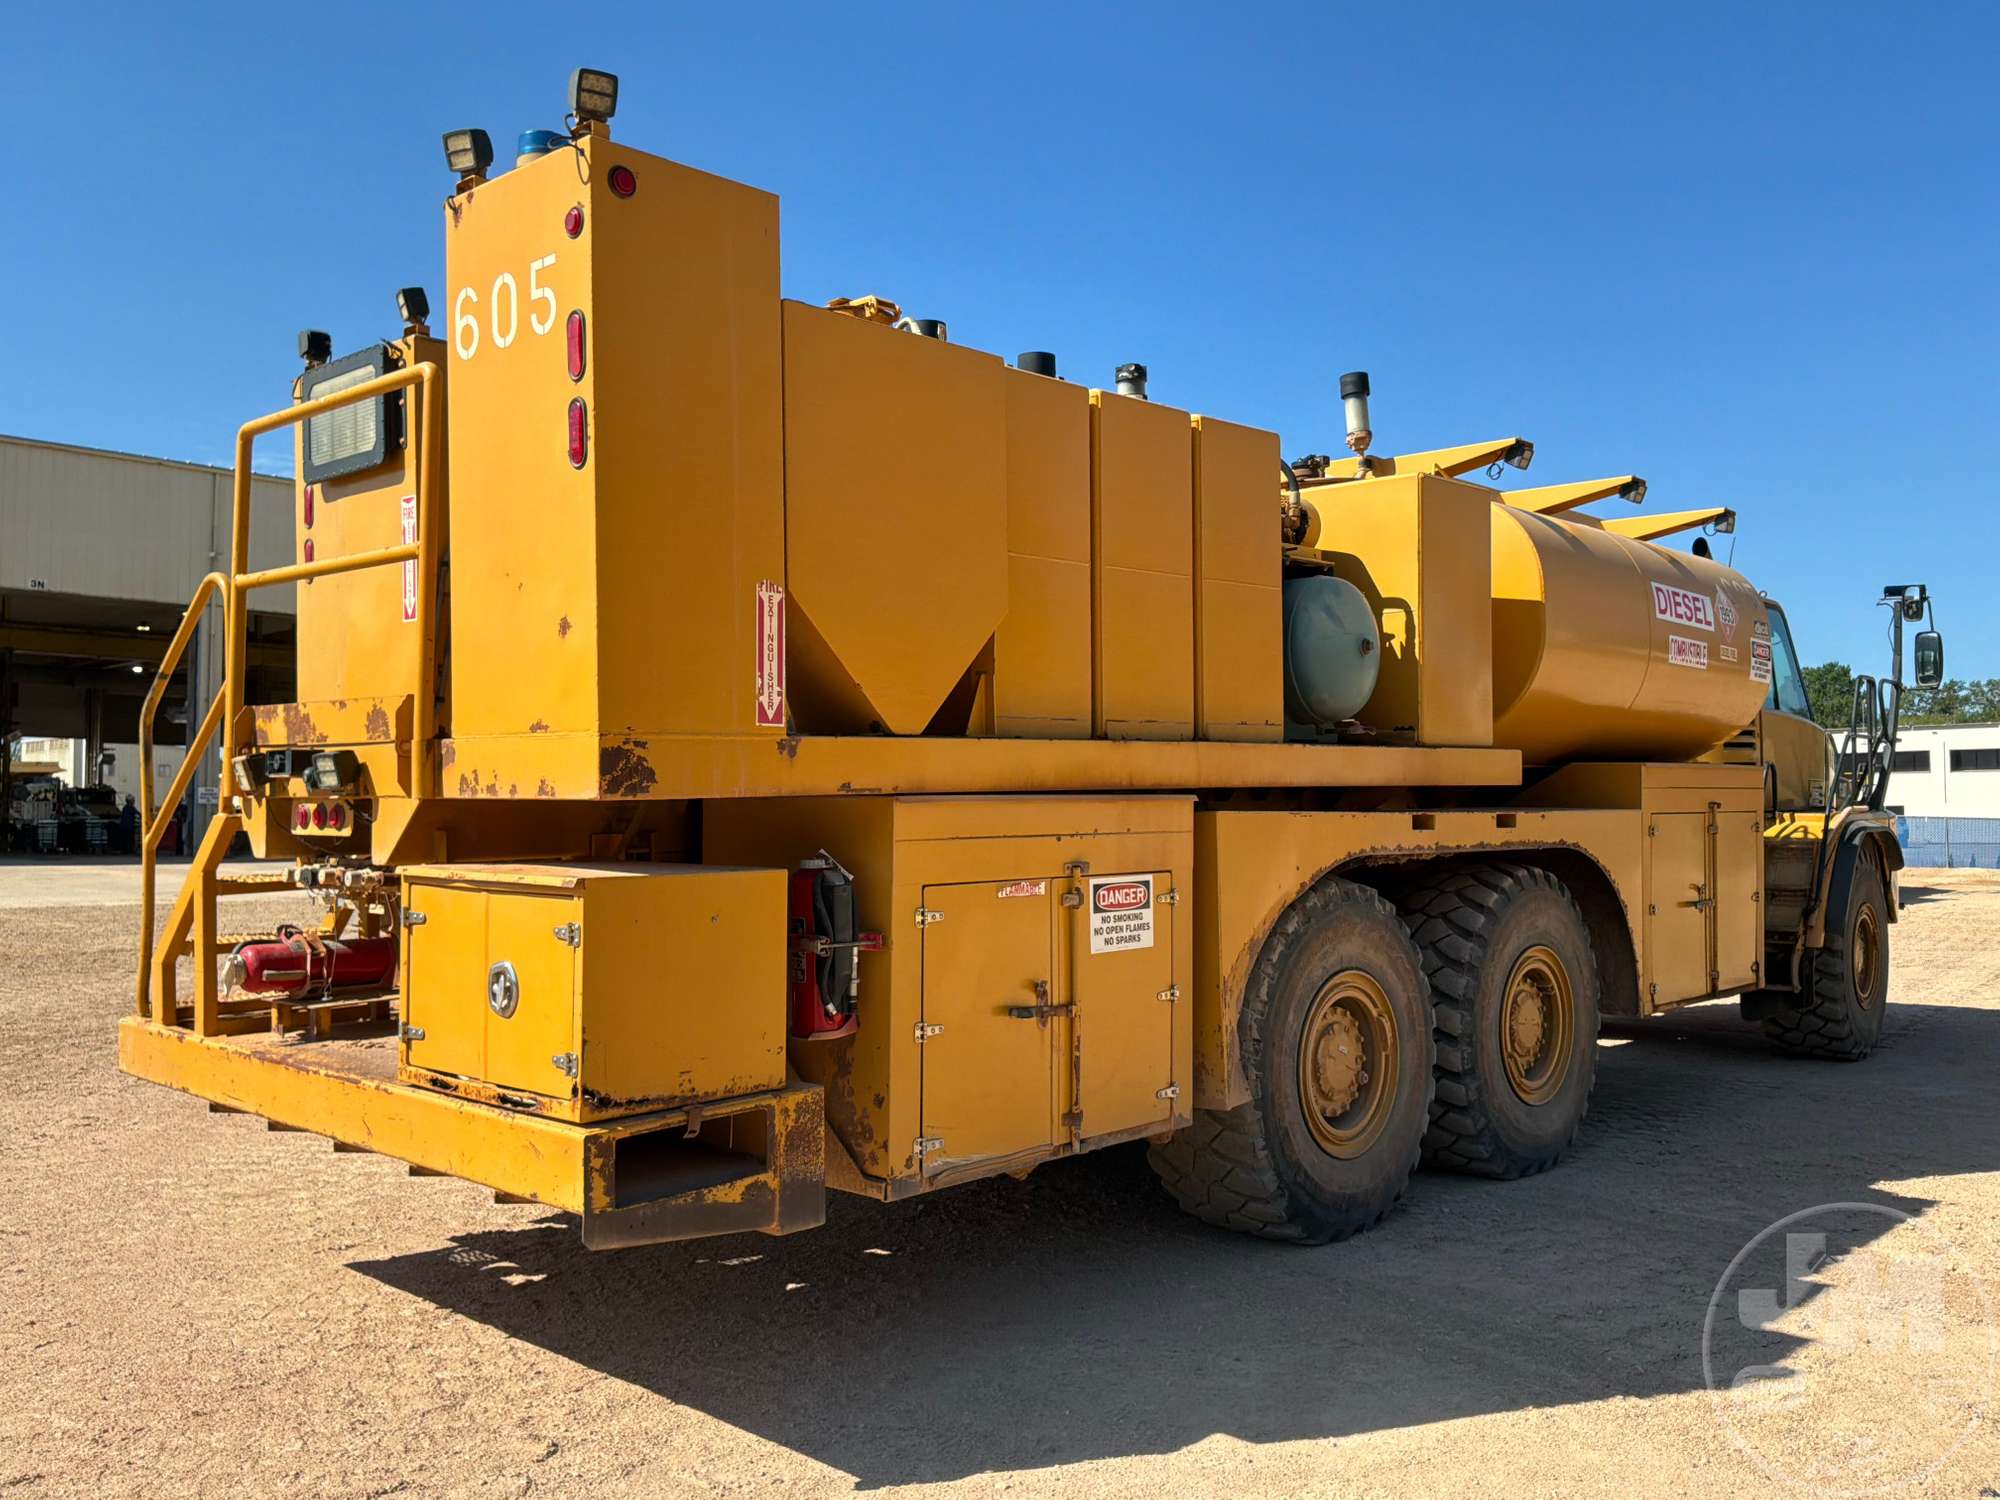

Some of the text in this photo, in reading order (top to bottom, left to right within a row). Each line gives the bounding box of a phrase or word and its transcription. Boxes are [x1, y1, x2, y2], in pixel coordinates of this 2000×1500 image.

[455, 252, 557, 361] 605
[1655, 586, 1713, 627] DIESEL
[767, 594, 775, 711] EXTINGUISHER
[1100, 887, 1145, 906] DANGER
[1101, 912, 1143, 924] NO SMOKING
[1094, 922, 1150, 936] NO OPEN FLAMES
[1104, 934, 1141, 946] NO SPARKS
